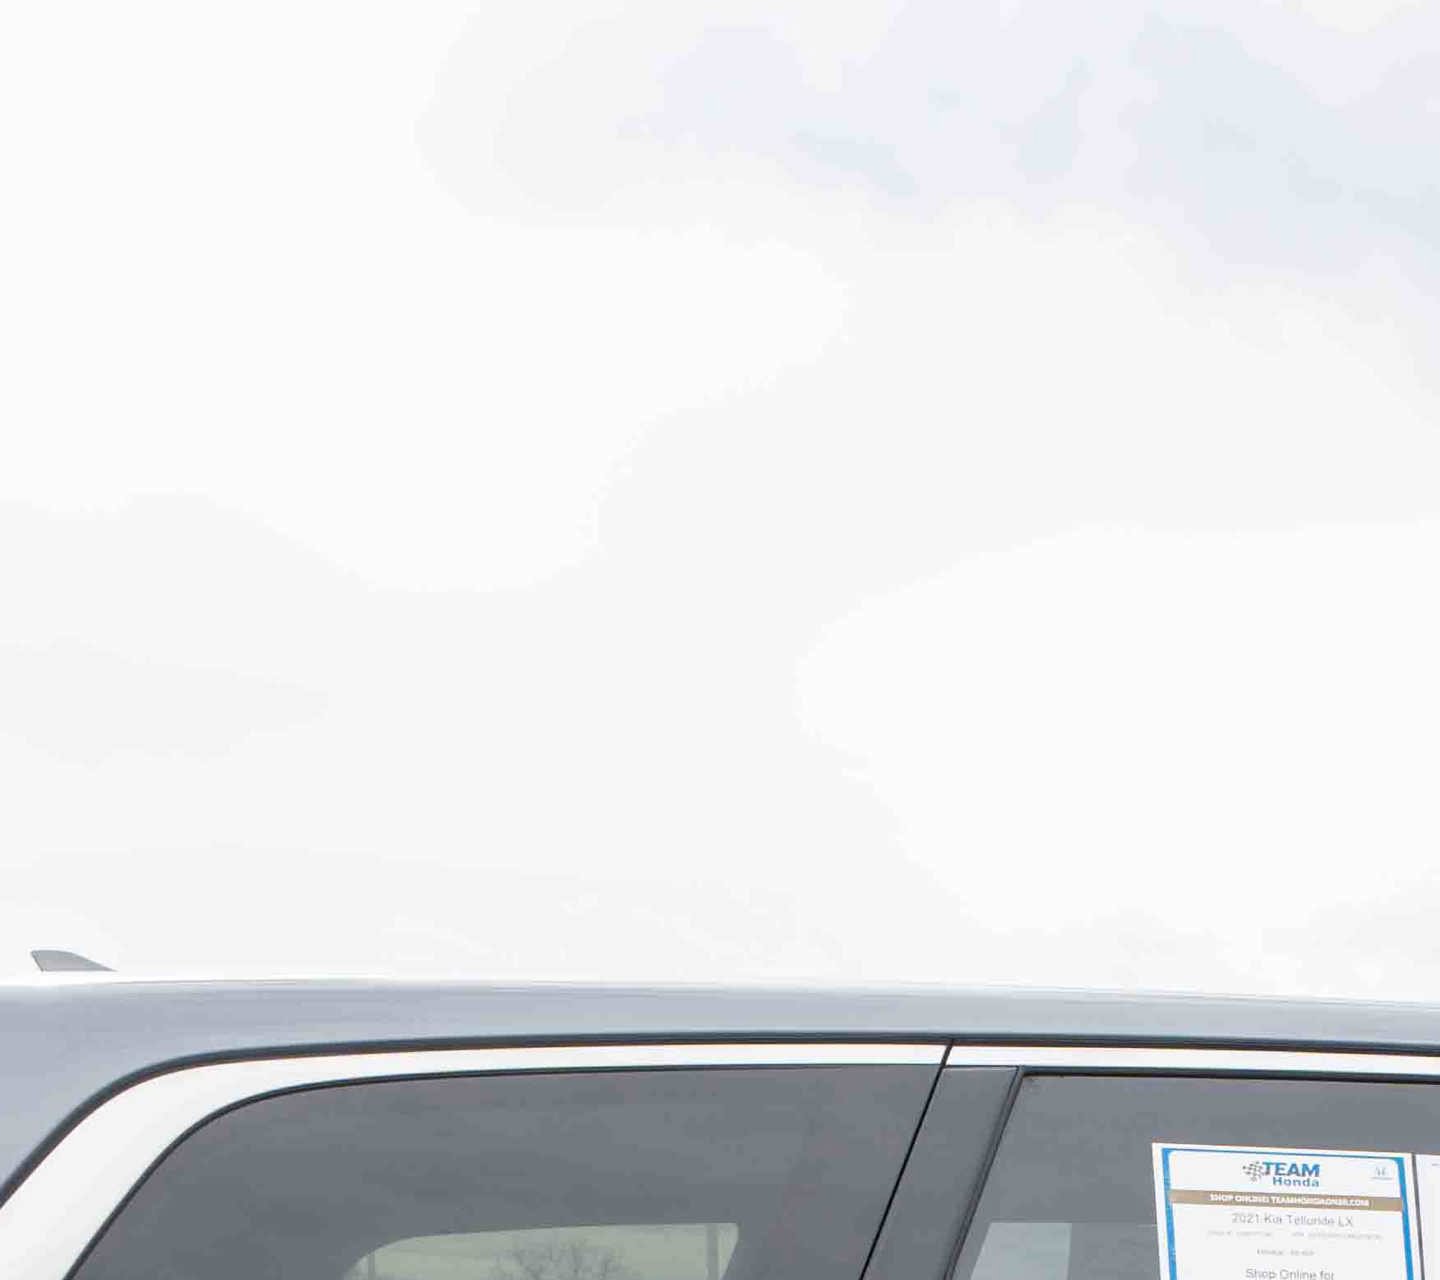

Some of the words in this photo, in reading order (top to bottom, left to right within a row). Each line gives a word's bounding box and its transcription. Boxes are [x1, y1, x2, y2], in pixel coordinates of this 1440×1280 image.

[1263, 1162, 1320, 1177] TEAM
[1272, 1177, 1320, 1188] Honda
[1231, 1213, 1259, 1224] 2021
[1337, 1217, 1354, 1227] LX
[1245, 1268, 1277, 1280] Shop
[1279, 1269, 1317, 1280] Online
[1319, 1270, 1335, 1280] for
